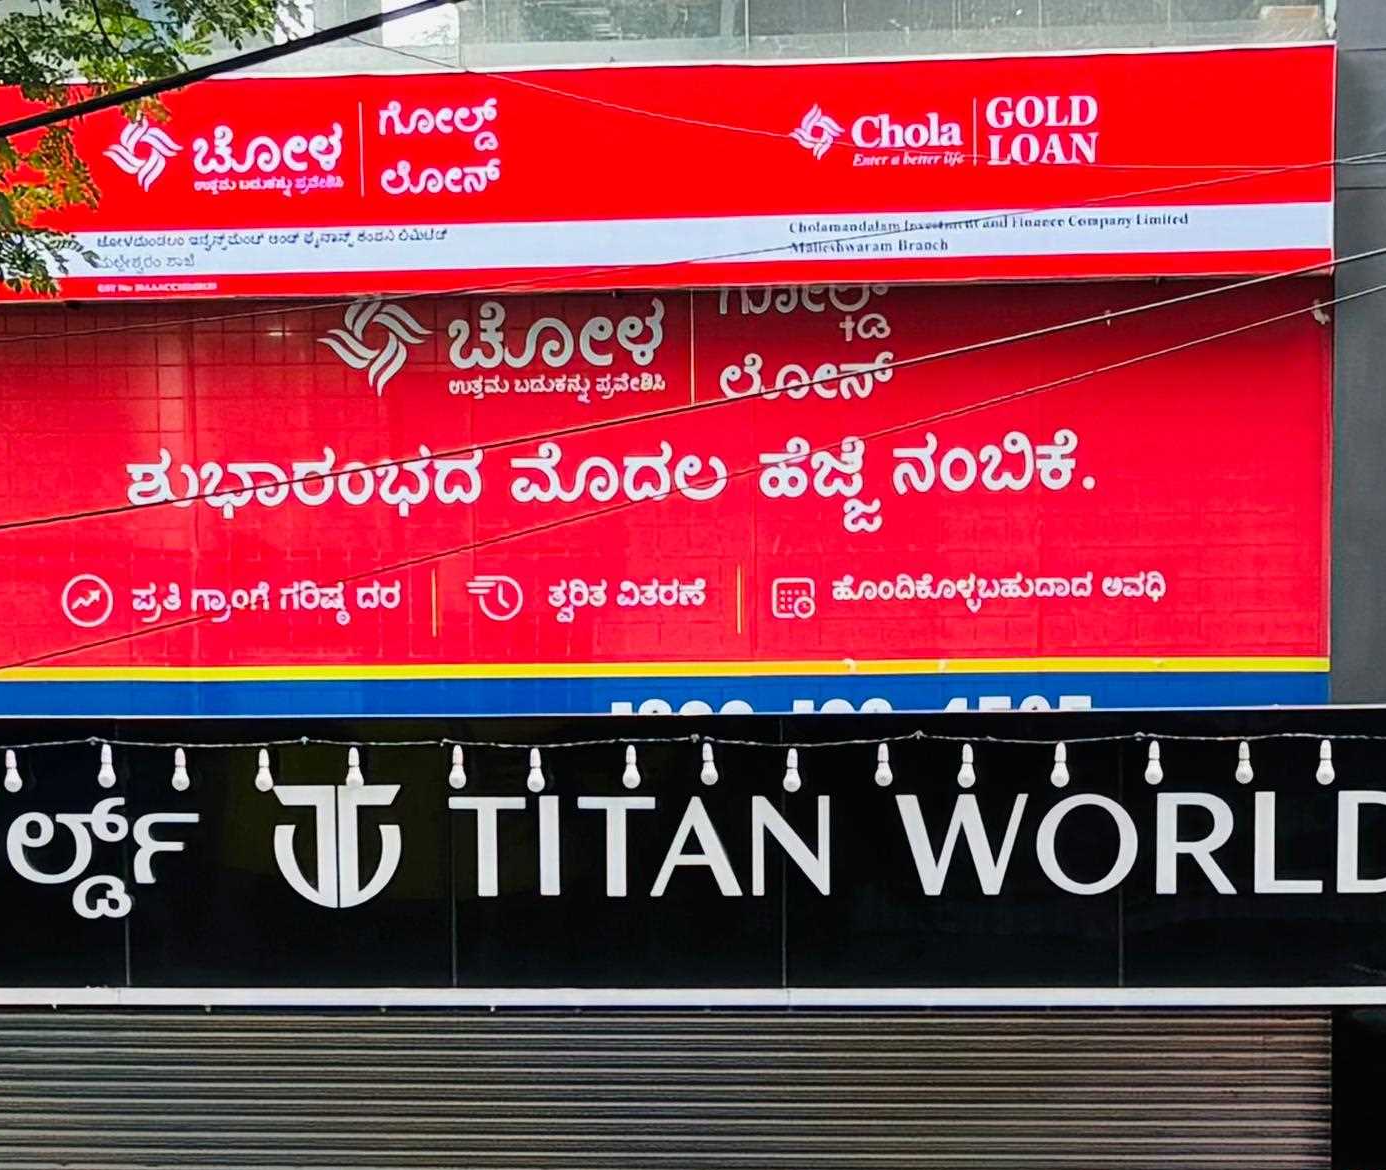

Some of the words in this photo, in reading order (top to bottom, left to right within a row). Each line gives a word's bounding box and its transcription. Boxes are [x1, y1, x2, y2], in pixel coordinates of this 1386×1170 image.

[378, 97, 500, 151] ಗೋಲ್ಡ್
[851, 112, 964, 149] Chola
[985, 95, 1098, 128] GOLD
[193, 122, 344, 174] ಚೋಳ
[853, 153, 888, 167] Enter
[891, 156, 900, 166] a
[903, 152, 941, 167] better
[986, 132, 1099, 166] LOAN
[381, 158, 501, 196] ಲೋನ್
[789, 221, 901, 234] Cholamandalam
[1068, 214, 1131, 229] Company
[1137, 213, 1189, 226] Limited
[898, 239, 948, 251] Branch
[448, 297, 665, 369] ಚೋಳ
[448, 375, 509, 399] ಉತ್ತಮ
[514, 374, 591, 403] ಬದುಕನ್ನು
[720, 351, 894, 399] ಲೋನ್
[125, 447, 485, 519] ಶುಭಾರಂಭದ
[509, 440, 728, 505] ಮೊದಲ
[757, 436, 885, 533] ಹೆಜ್ಜೆ
[131, 582, 182, 623] ಪ್ರತಿ
[191, 581, 270, 623] ಗ್ರಾಂಗೆ
[356, 579, 401, 609] ದರ
[548, 578, 608, 623] ತ್ವರಿತ
[616, 577, 706, 607] ವಿತರಣೆ
[1101, 569, 1167, 603] ಅವಧಿ
[448, 794, 831, 897] TITAN
